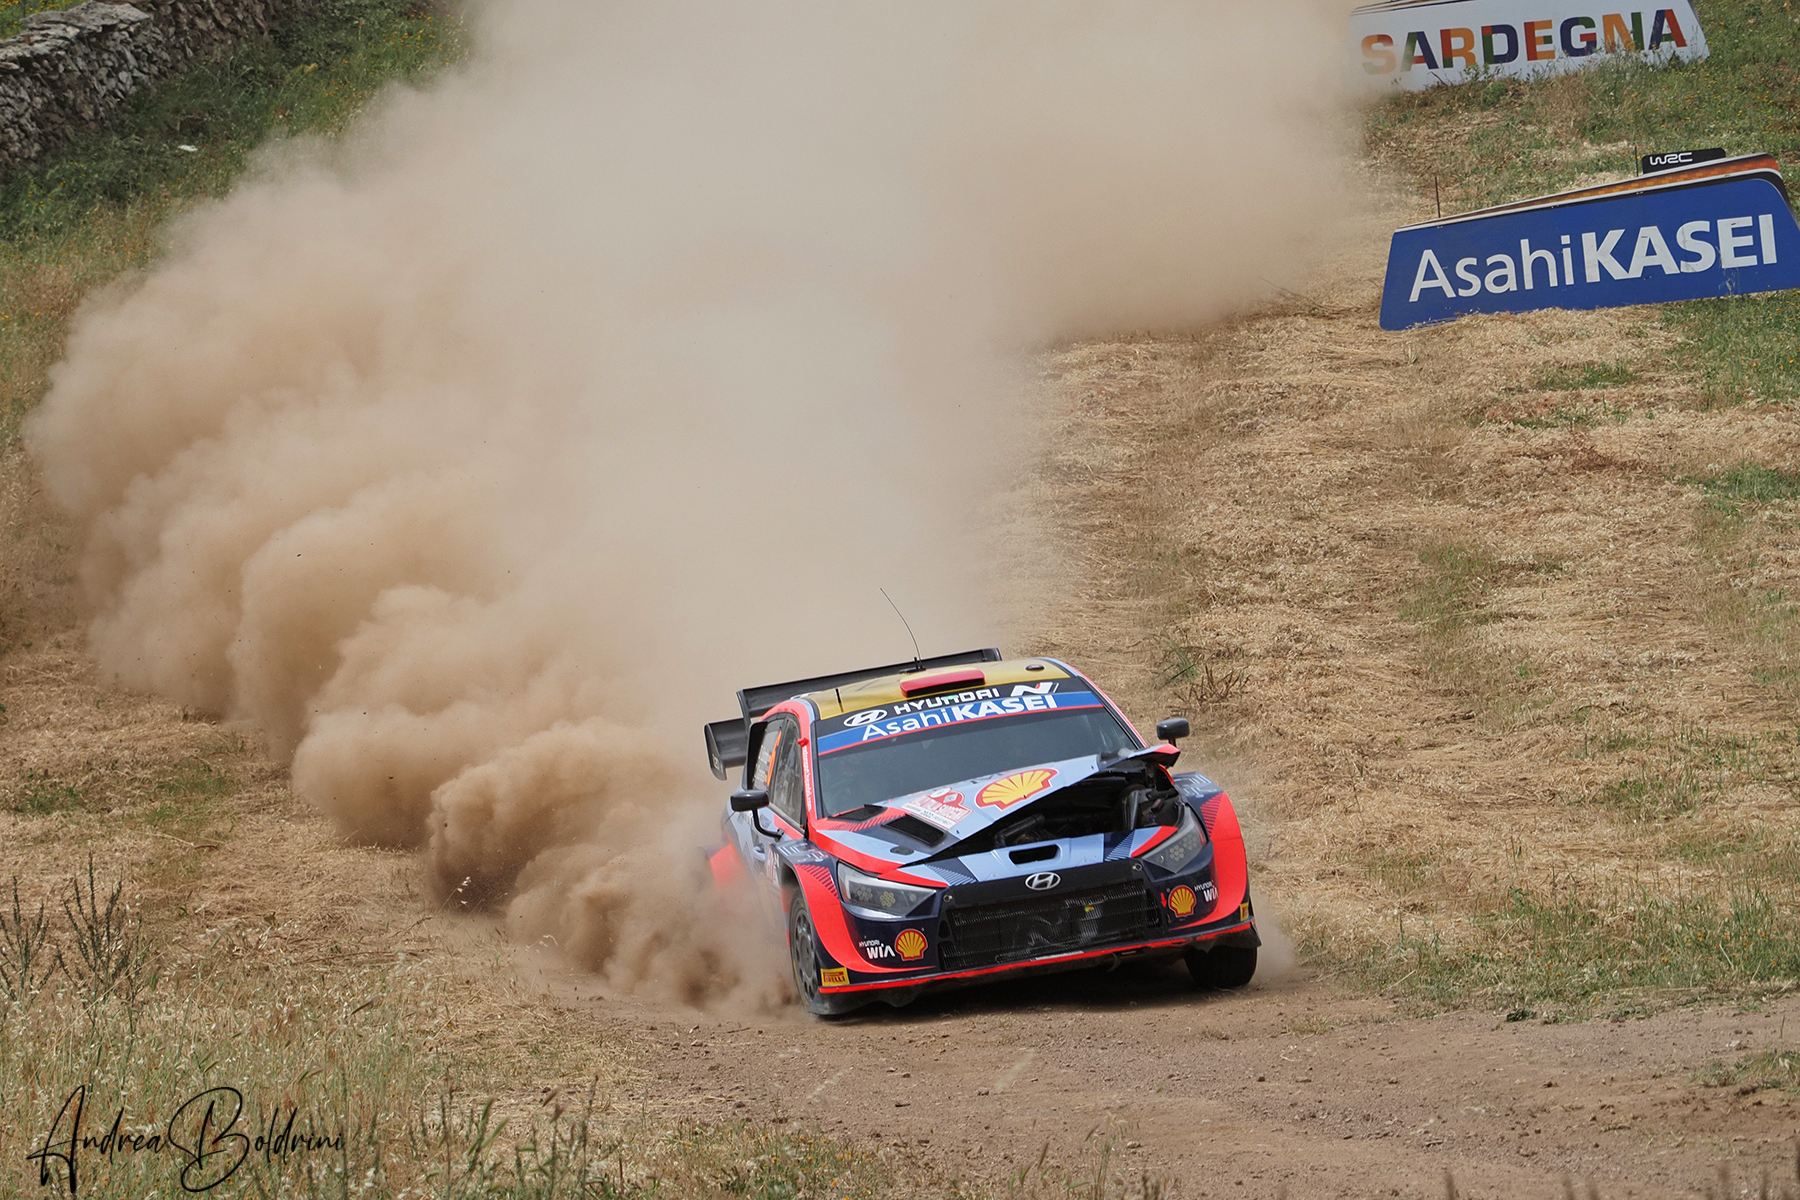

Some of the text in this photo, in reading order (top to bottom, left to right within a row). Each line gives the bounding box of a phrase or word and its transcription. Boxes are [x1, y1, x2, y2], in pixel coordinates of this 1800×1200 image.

[1360, 9, 1688, 76] SARDEGNA
[1649, 152, 1693, 166] WRC
[893, 688, 1001, 715] HYUNDAI
[822, 971, 846, 983] PIRELLI
